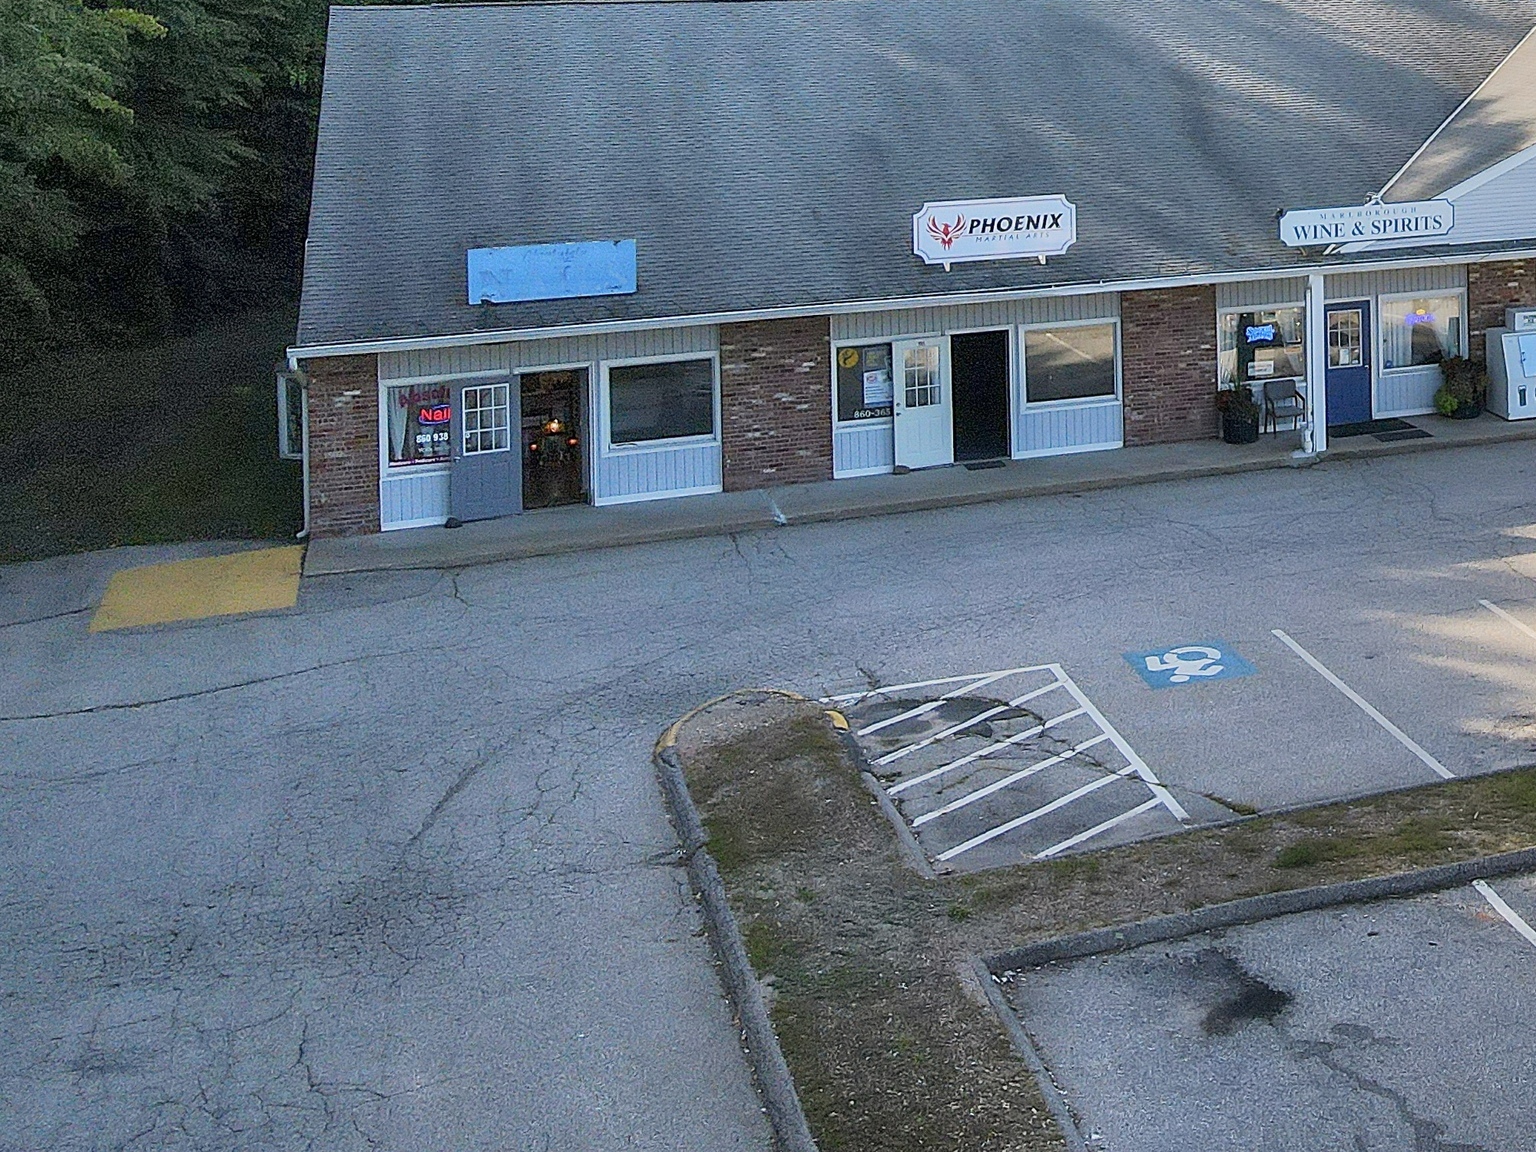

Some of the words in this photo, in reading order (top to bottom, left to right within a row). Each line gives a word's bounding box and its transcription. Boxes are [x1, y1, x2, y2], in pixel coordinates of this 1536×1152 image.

[1319, 206, 1418, 220] MARLBOROUGH
[968, 213, 1064, 234] PHOENIX
[1292, 222, 1346, 241] WINE
[1351, 221, 1365, 236] &
[1371, 215, 1443, 235] SPIRITS
[975, 234, 1020, 243] MARTIAL
[1026, 231, 1050, 239] ARTS
